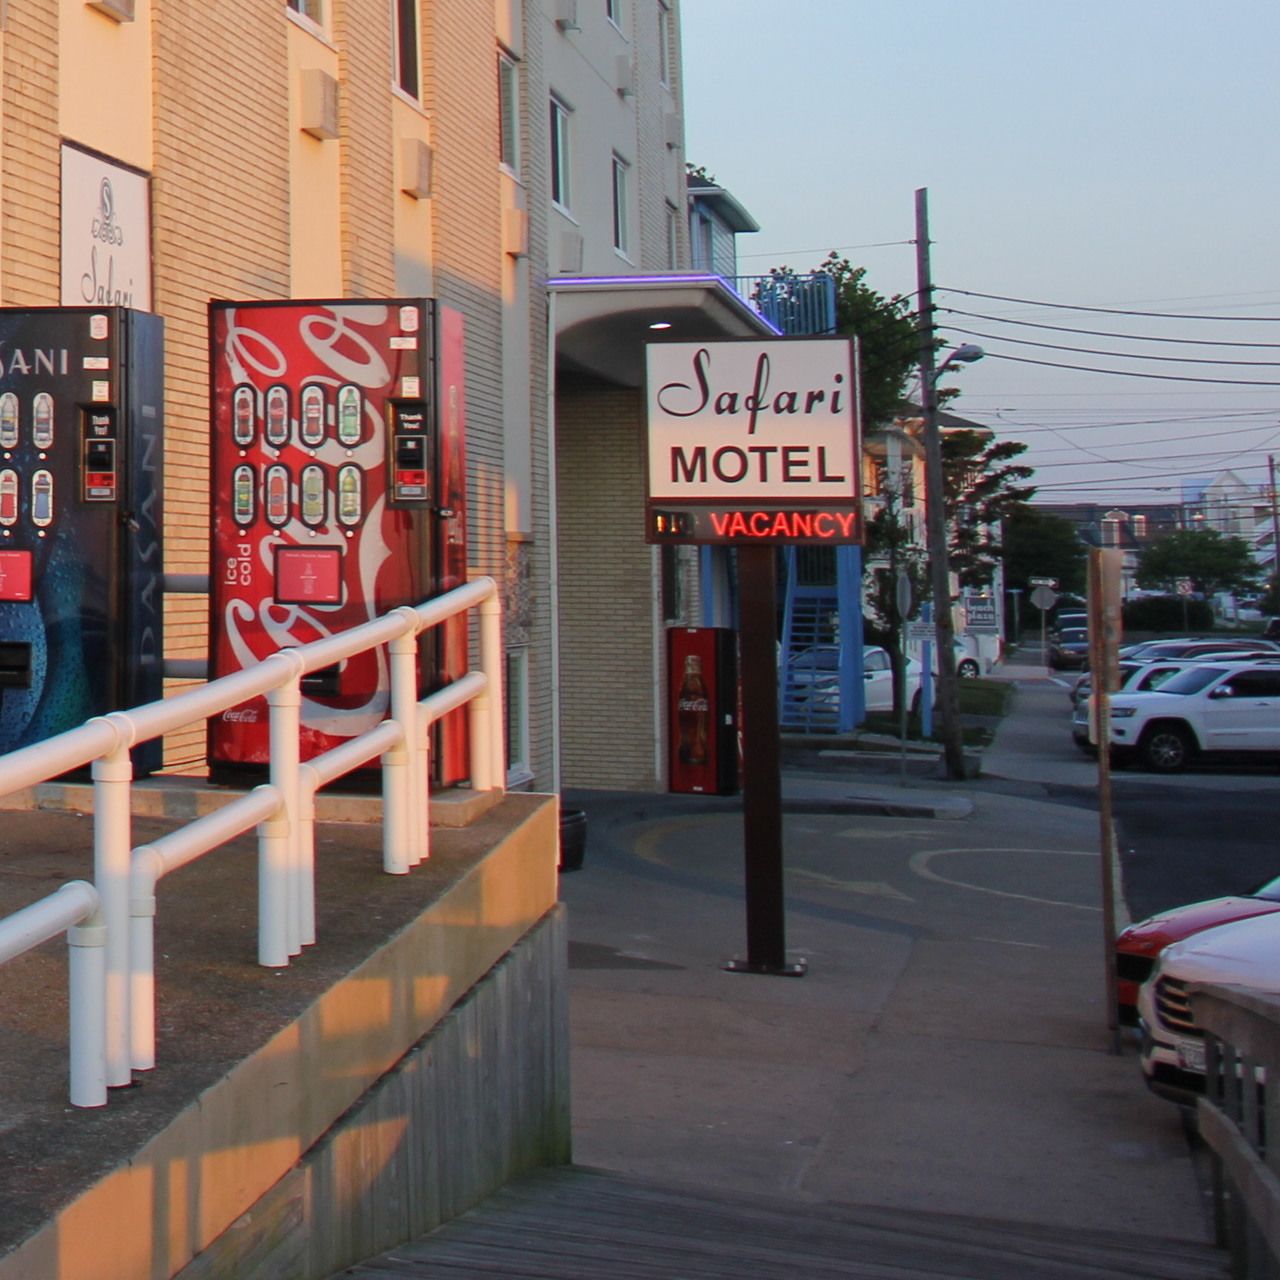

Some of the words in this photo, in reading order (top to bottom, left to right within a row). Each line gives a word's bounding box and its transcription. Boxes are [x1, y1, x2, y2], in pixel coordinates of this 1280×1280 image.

[80, 245, 133, 307] Safari
[656, 348, 844, 435] Safari
[399, 413, 423, 421] Thank
[670, 445, 845, 483] MOTEL
[138, 404, 158, 664] DASANI
[710, 511, 855, 538] VACANCY
[224, 557, 238, 586] ice
[237, 543, 252, 586] cold
